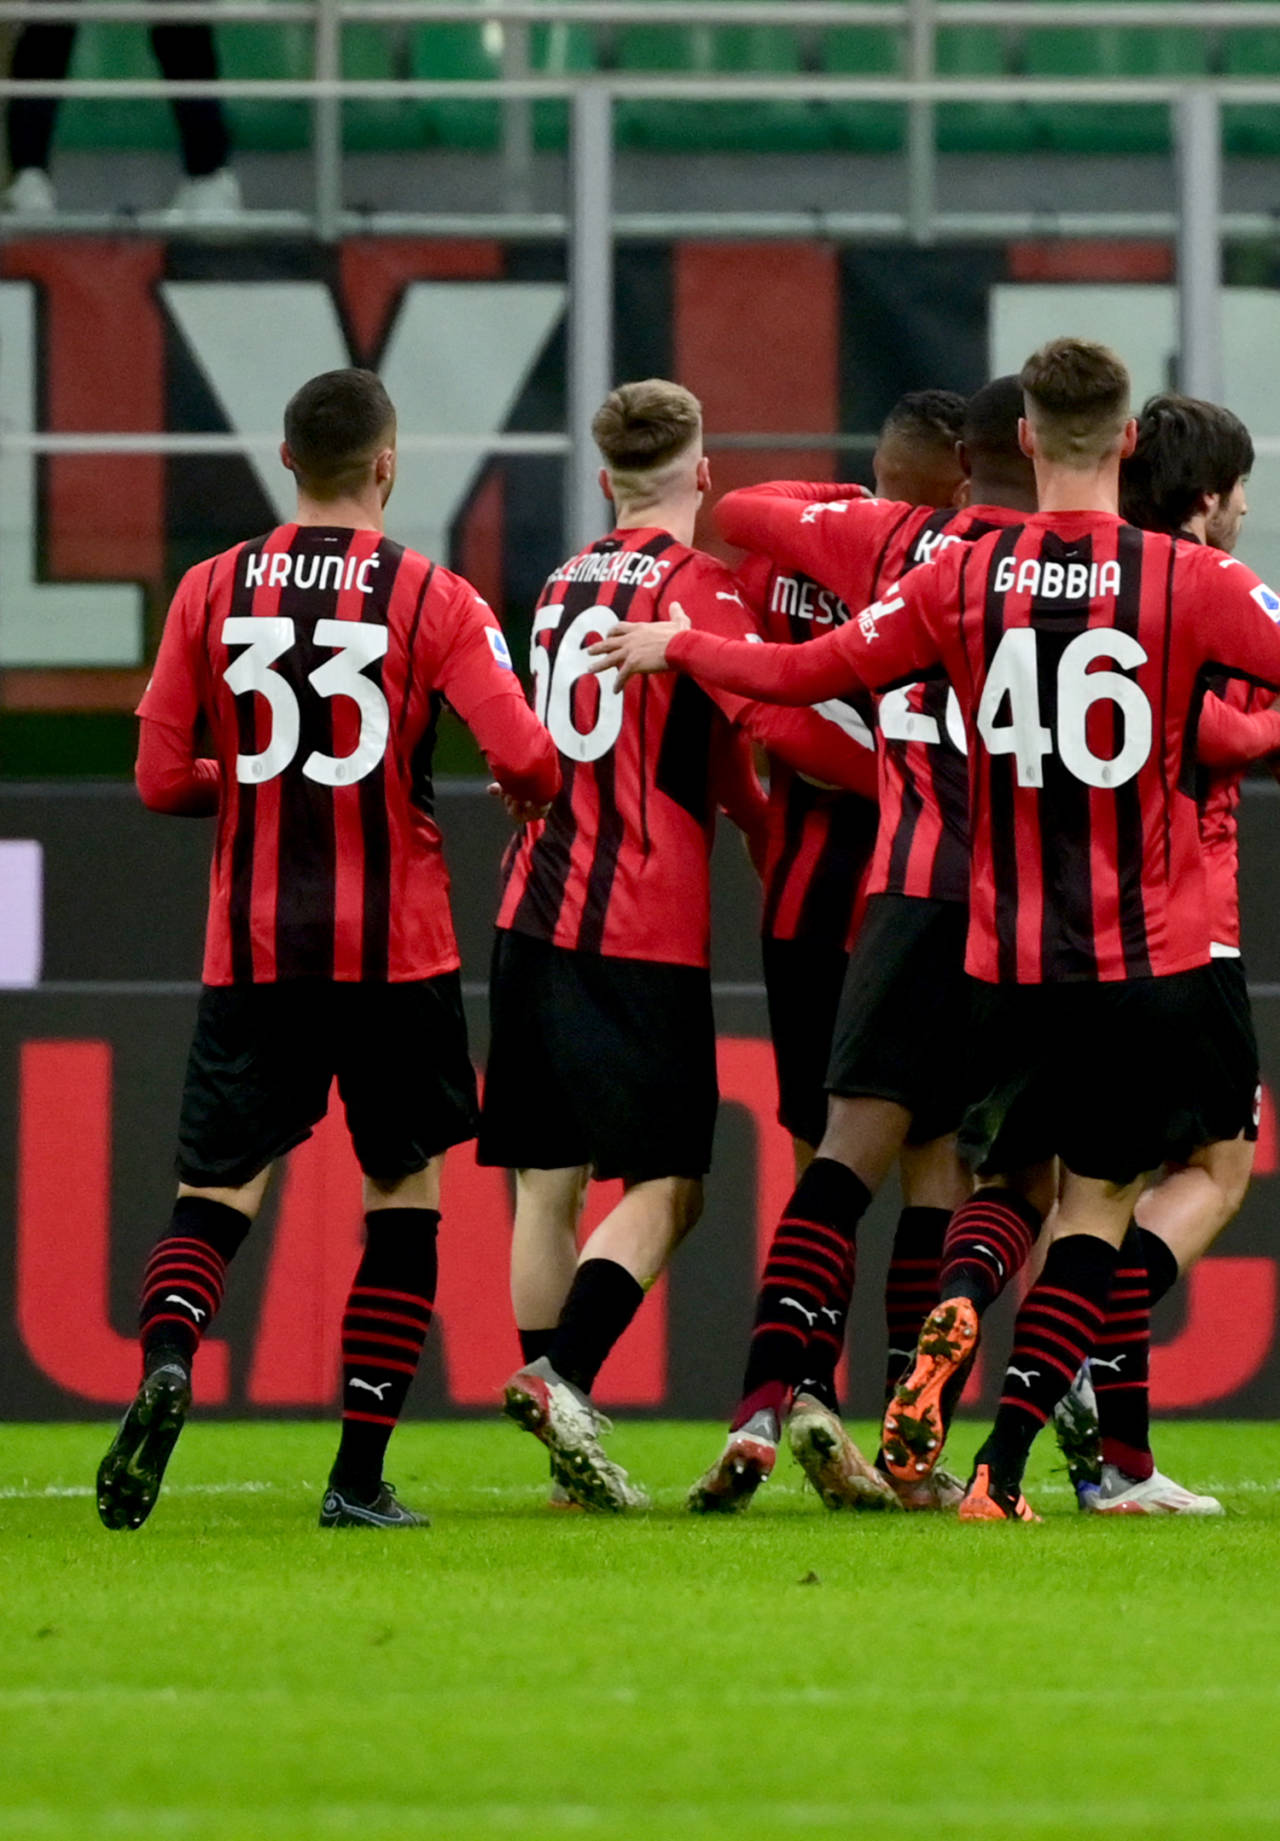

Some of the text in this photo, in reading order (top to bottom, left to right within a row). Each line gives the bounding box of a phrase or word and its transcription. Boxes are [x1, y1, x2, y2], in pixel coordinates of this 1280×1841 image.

[245, 552, 380, 593] KRUNIĆ
[994, 557, 1121, 599] GABBIA
[221, 617, 390, 786] 33
[530, 604, 623, 762] 56
[977, 627, 1153, 788] 46
